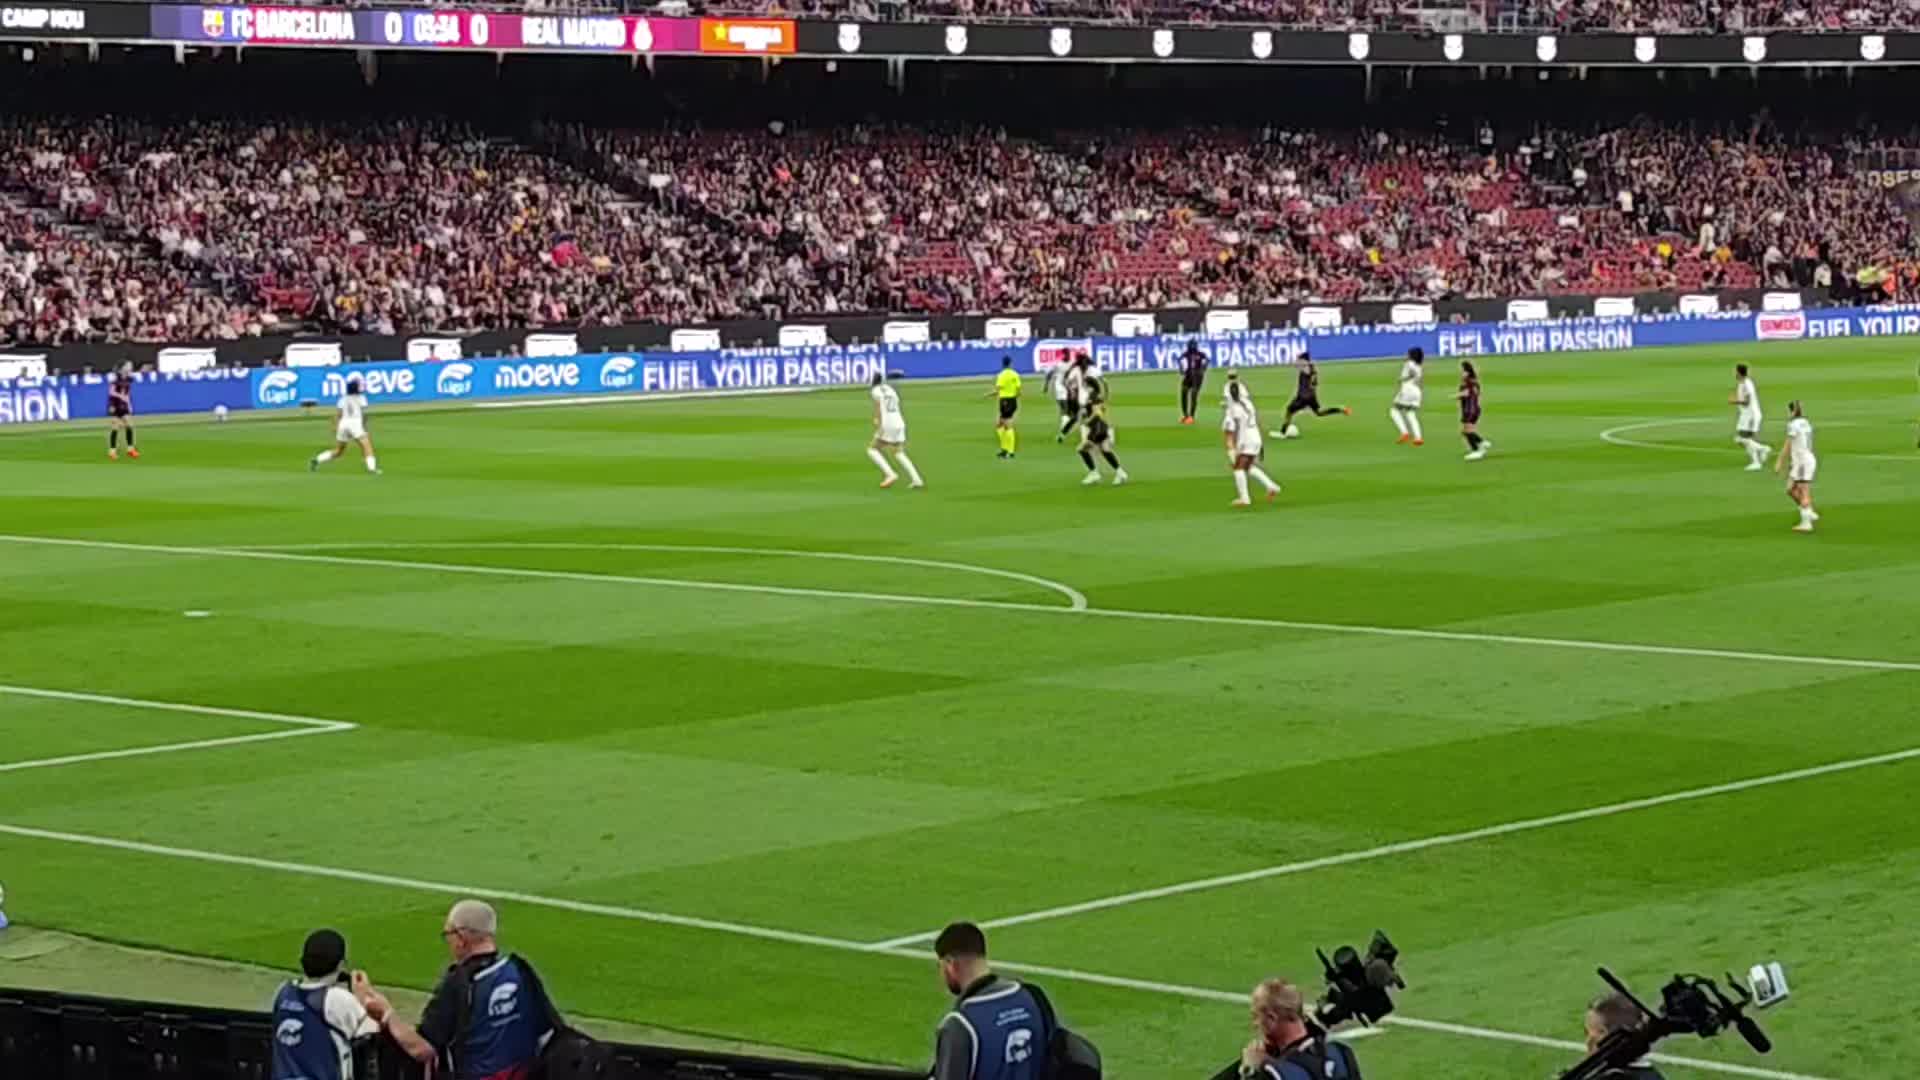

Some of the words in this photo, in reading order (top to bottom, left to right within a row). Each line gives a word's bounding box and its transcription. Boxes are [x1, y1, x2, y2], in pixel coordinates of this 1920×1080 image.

[2, 8, 48, 27] CAMP
[50, 9, 85, 29] NOU
[232, 9, 253, 37] FC
[256, 10, 355, 40] BARCELONA
[385, 11, 402, 43] 0
[471, 13, 488, 45] 0
[521, 16, 561, 44] REAL
[562, 17, 626, 47] MADRID
[1215, 336, 1307, 367] PASSION
[1438, 327, 1486, 356] FUEL
[1491, 325, 1546, 353] YOUR
[1549, 322, 1633, 351] PASSION
[495, 362, 580, 388] moeve
[643, 360, 703, 392] FUEL
[711, 358, 778, 387] YOUR
[784, 352, 887, 385] PASSION
